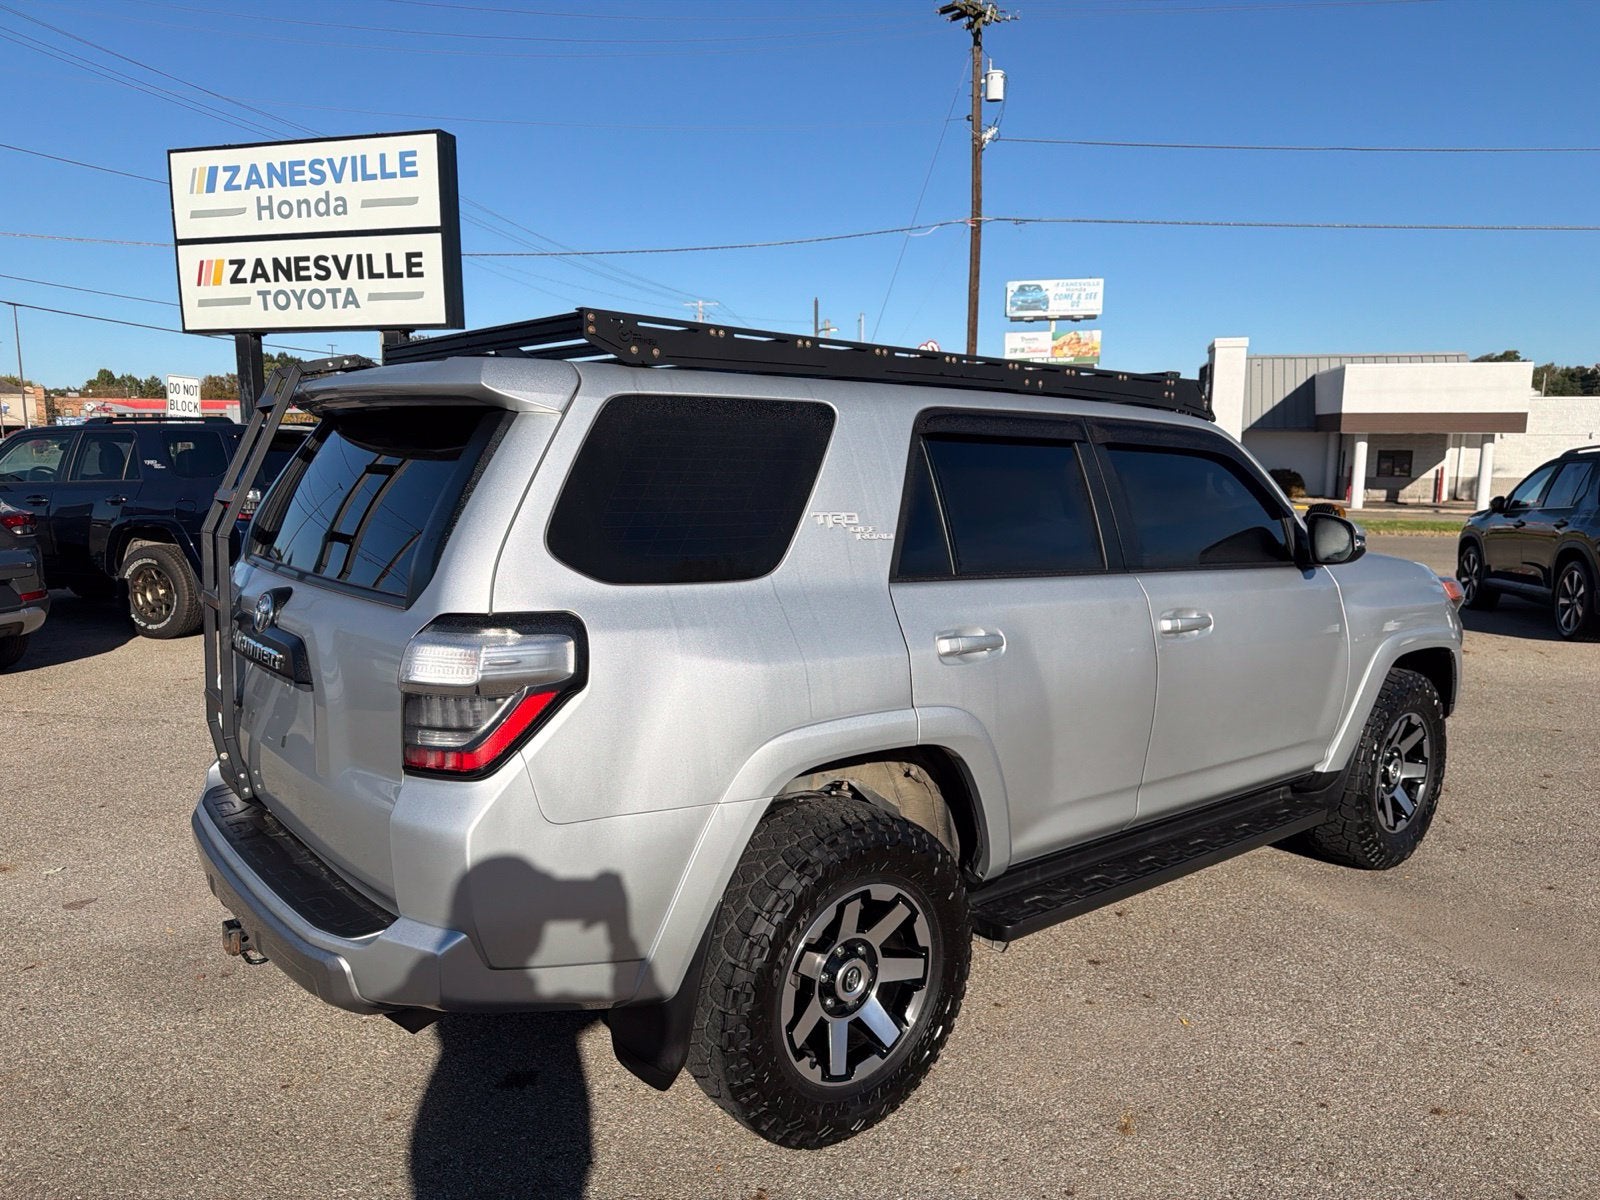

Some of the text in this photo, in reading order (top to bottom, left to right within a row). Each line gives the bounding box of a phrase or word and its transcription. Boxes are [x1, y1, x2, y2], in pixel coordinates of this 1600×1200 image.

[222, 150, 419, 192] ZANESVILLE
[256, 191, 349, 221] Honda
[228, 251, 425, 285] ZANESVILLE
[257, 287, 361, 311] TOYOTA
[170, 382, 199, 396] DO NOT
[170, 399, 199, 413] BLOCK
[811, 511, 859, 528] TRD
